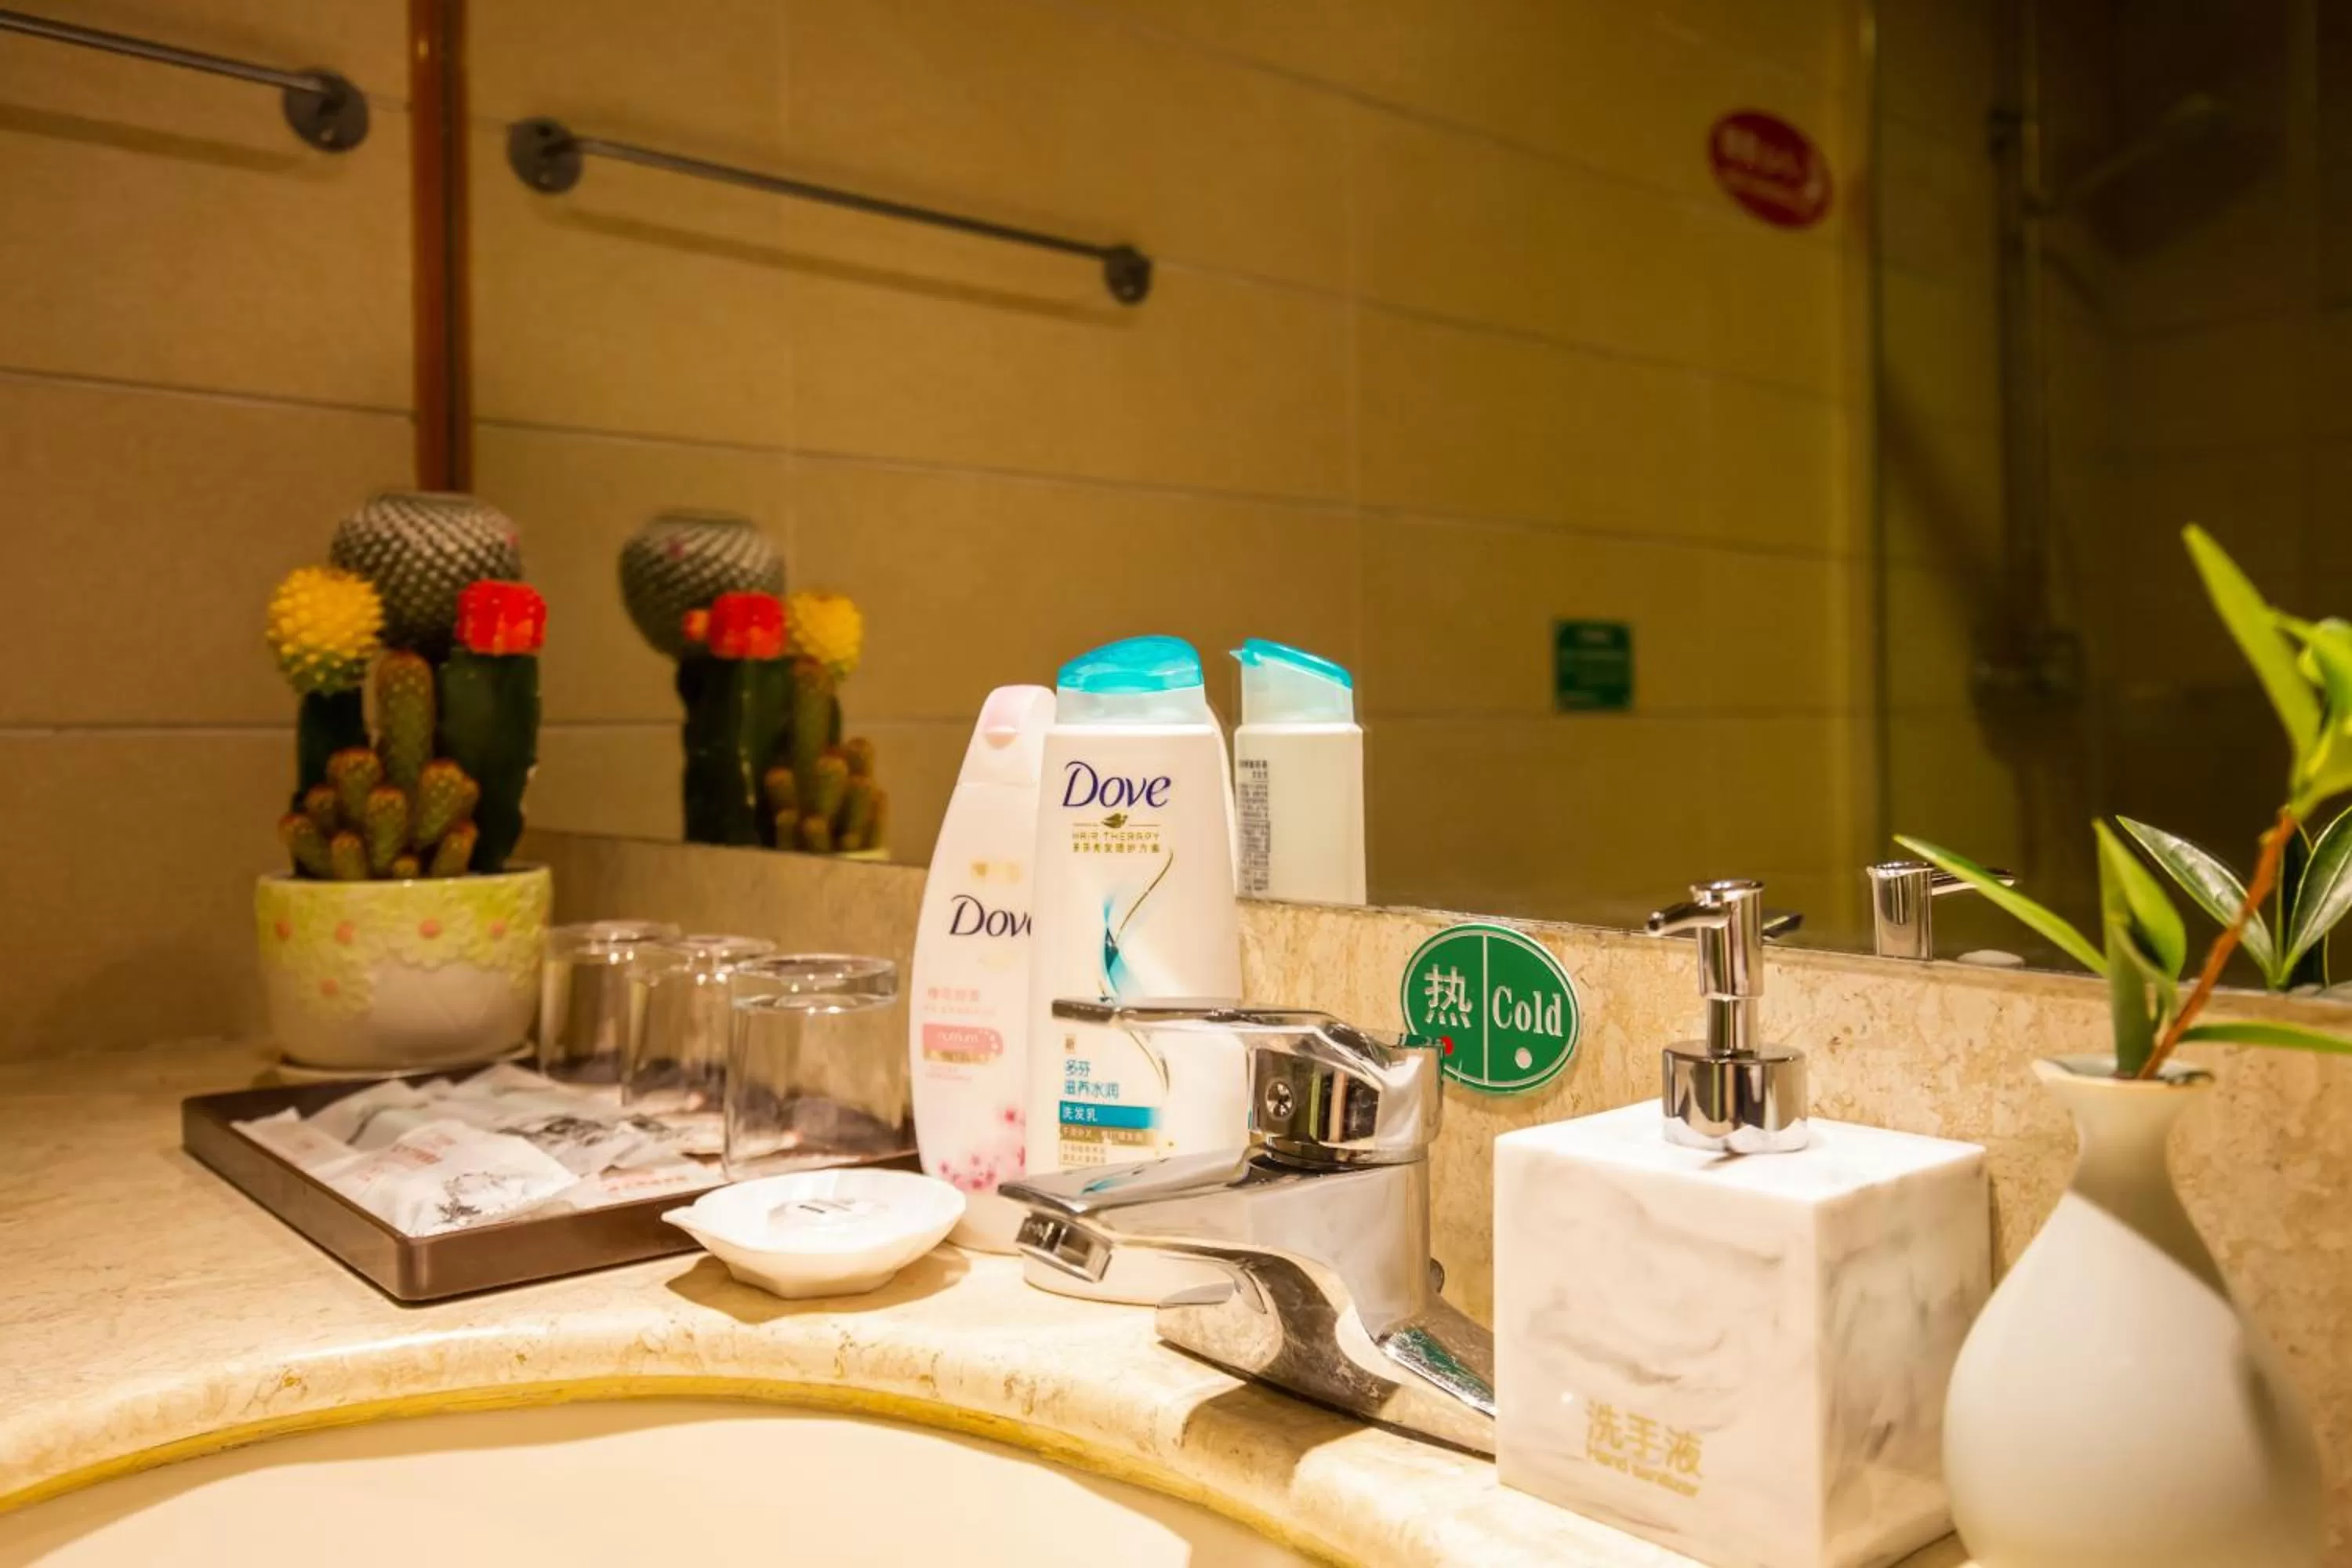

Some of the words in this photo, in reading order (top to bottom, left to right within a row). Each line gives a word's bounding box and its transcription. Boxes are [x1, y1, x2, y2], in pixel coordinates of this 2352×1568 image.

[1062, 760, 1172, 808] Dove
[1073, 831, 1098, 840] HAIR
[1103, 831, 1160, 841] THERAPY
[949, 895, 1032, 938] Dov
[1424, 964, 1473, 1029] 热
[1492, 985, 1564, 1037] Cold
[1065, 1059, 1091, 1077] 多芬
[1064, 1080, 1120, 1100] 滋养水润
[1062, 1102, 1098, 1123] 洗发乳
[1584, 1398, 1704, 1479] 洗手液
